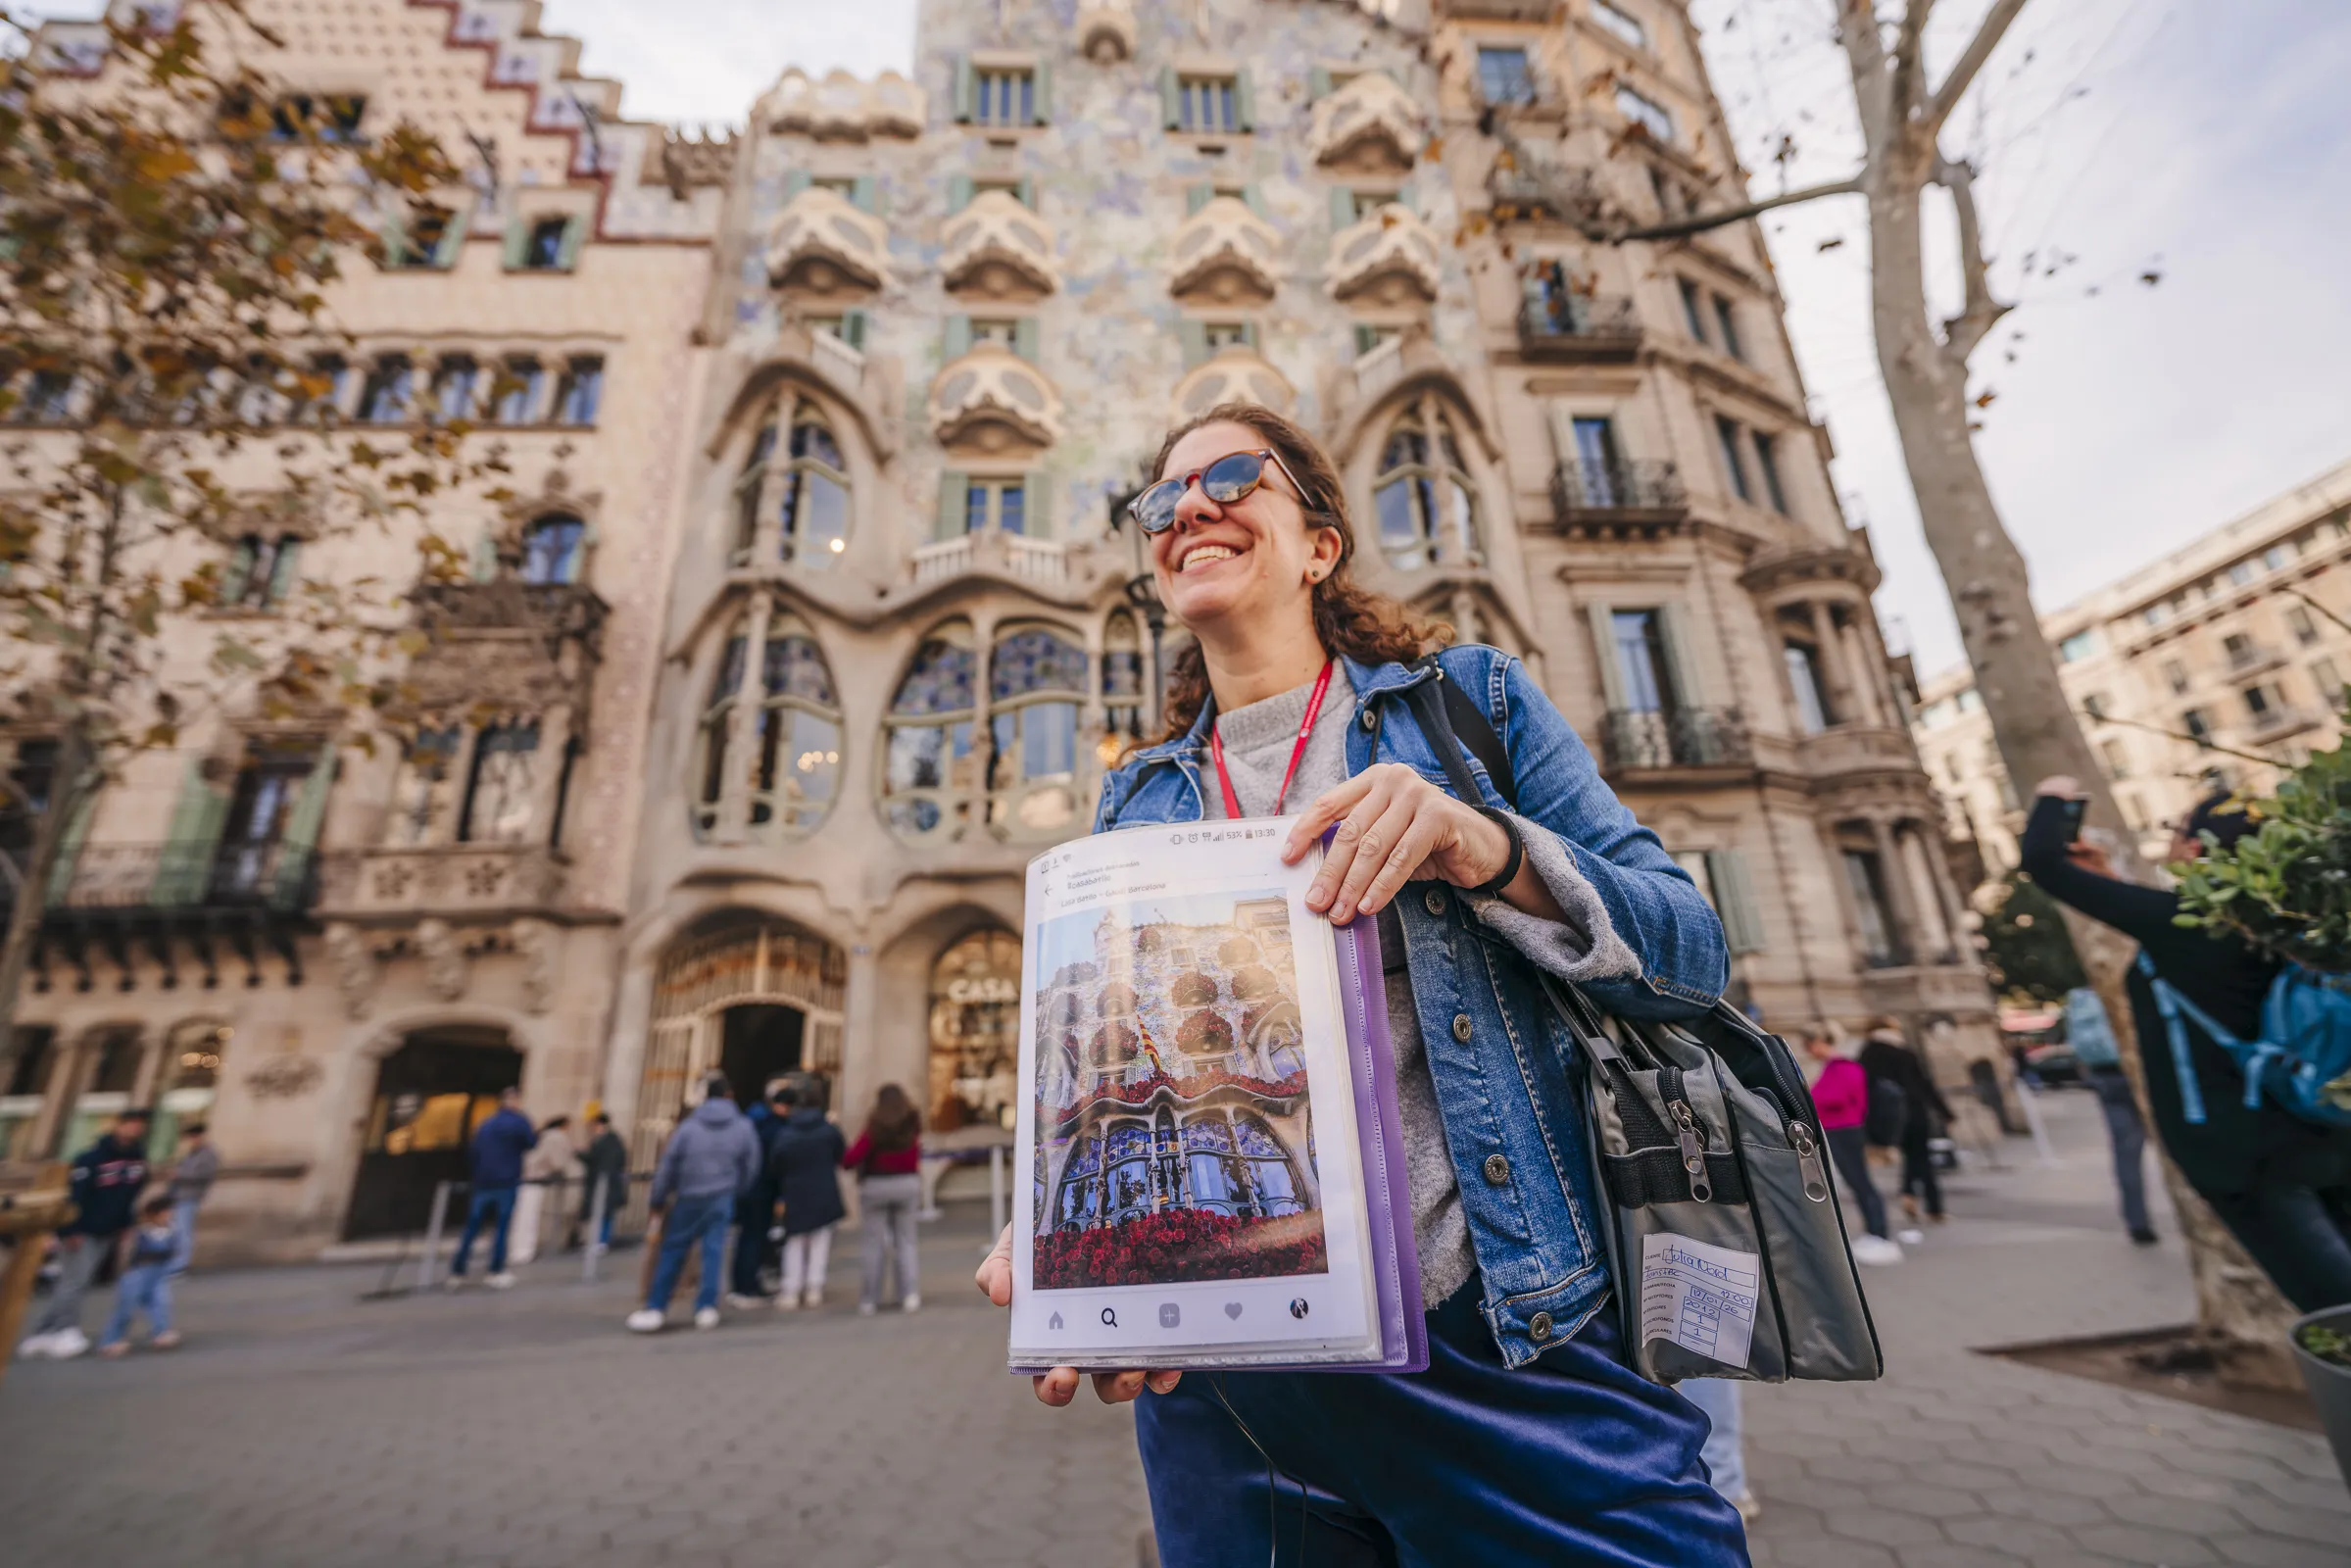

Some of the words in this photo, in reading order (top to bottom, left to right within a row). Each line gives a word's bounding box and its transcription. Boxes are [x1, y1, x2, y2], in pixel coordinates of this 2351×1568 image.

[1227, 831, 1243, 840] 53%
[1254, 828, 1275, 838] 13:30
[1128, 883, 1166, 894] Barcelona
[948, 978, 1018, 1003] CASA
[1694, 1328, 1701, 1337] 1
